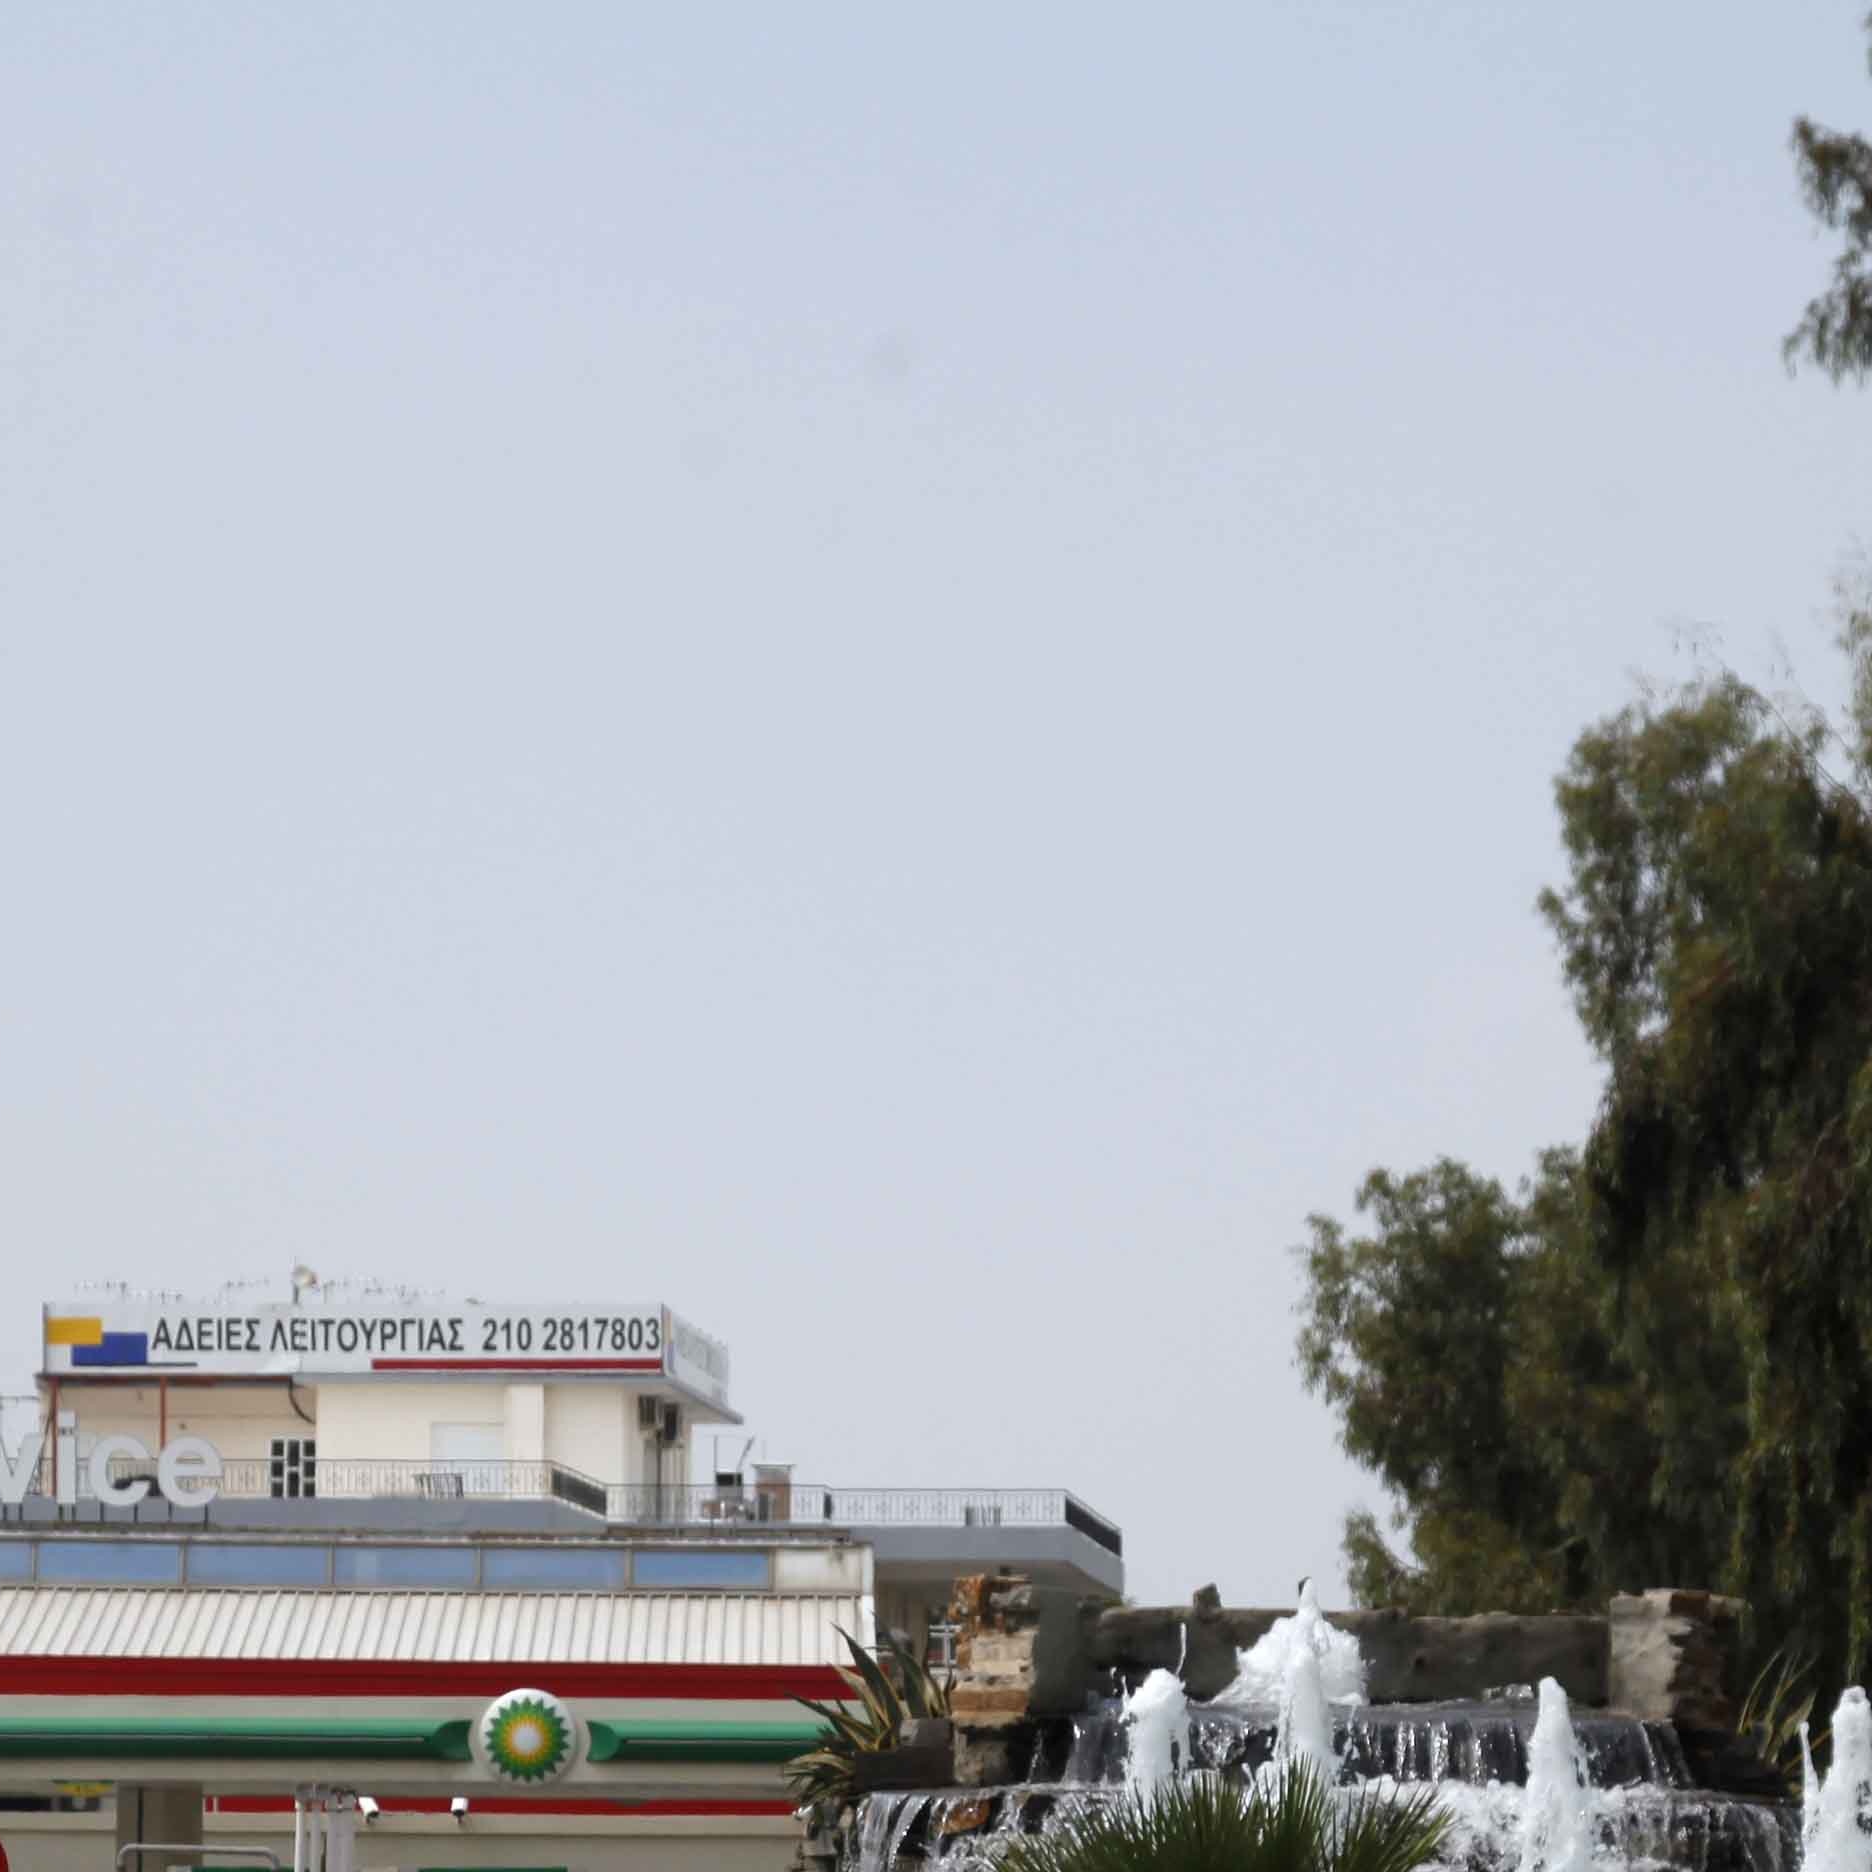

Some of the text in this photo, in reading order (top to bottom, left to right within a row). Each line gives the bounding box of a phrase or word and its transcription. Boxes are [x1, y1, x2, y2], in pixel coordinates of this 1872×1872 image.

[151, 1317, 261, 1351] ΑΔΕΙΕΣ
[270, 1317, 464, 1351] ΛΕΙΤΟΥΡΓΙΑΣ
[482, 1318, 532, 1351] 210
[543, 1318, 660, 1351] 2817803
